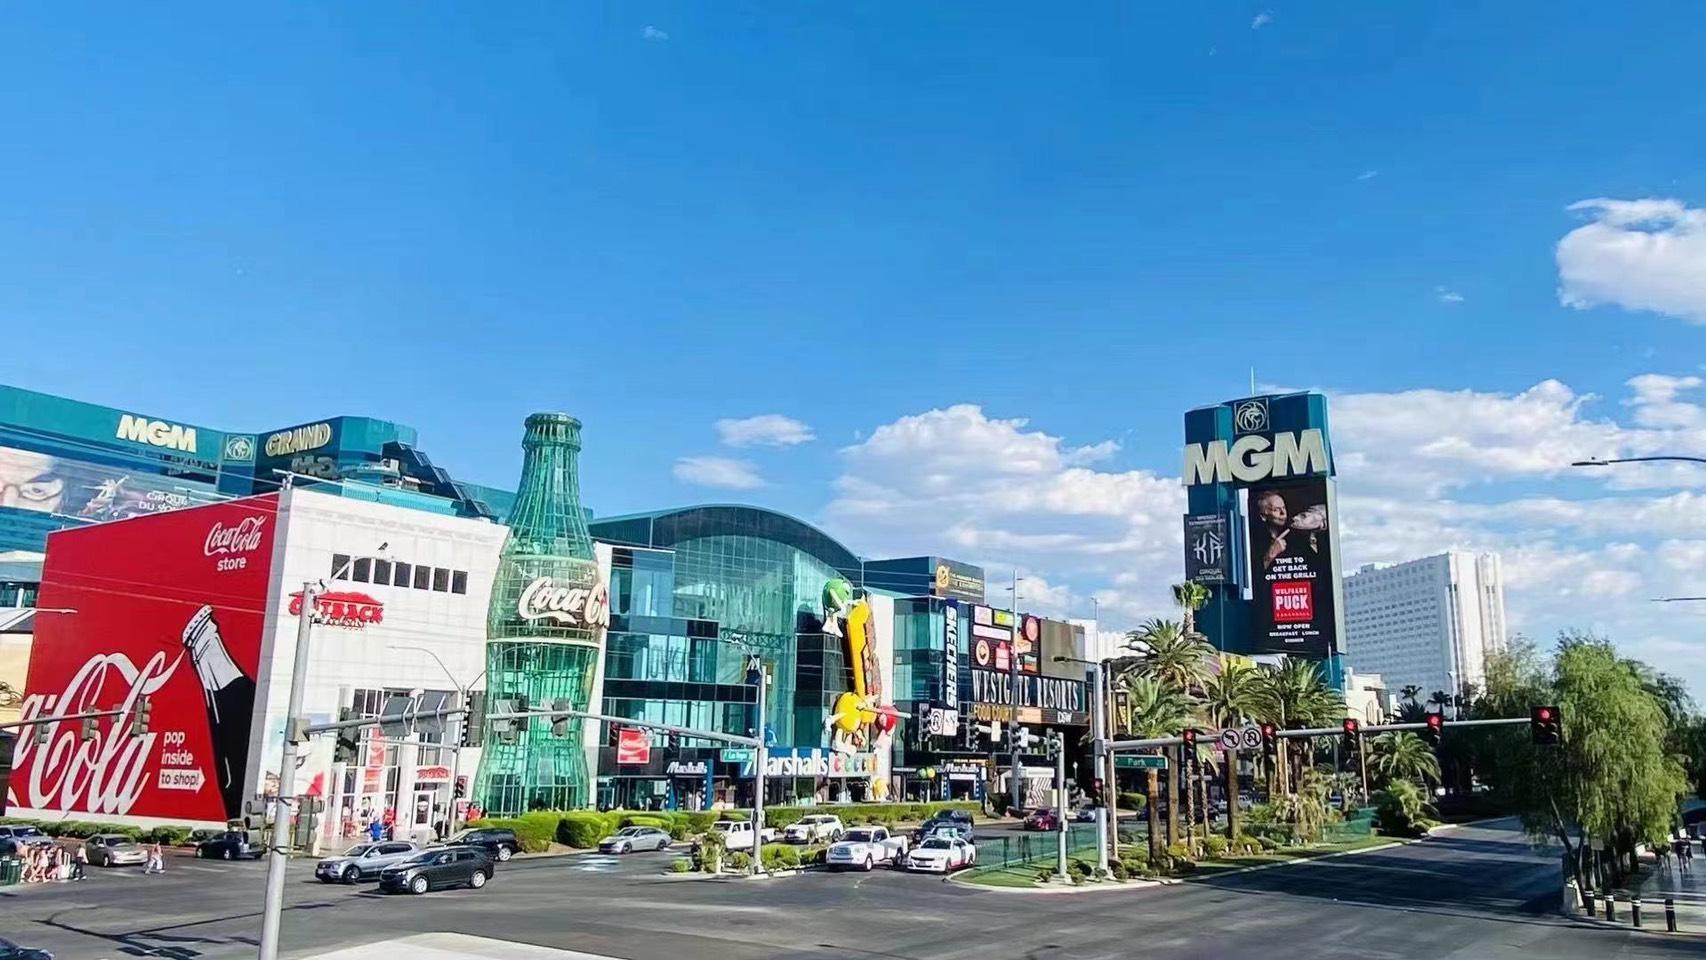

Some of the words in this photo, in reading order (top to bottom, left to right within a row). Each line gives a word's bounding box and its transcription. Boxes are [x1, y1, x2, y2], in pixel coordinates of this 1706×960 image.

[116, 414, 197, 453] MGM
[265, 423, 331, 457] GRAND
[1182, 428, 1328, 486] MGM
[204, 515, 267, 556] Coca-Cola
[217, 557, 247, 571] store
[1275, 595, 1309, 610] PUCK
[946, 605, 957, 709] SKECHERS
[1037, 677, 1079, 710] RESORTS
[163, 731, 186, 748] pop
[161, 749, 194, 766] inside
[1127, 758, 1147, 767] Park
[161, 772, 171, 785] to
[173, 770, 199, 788] shop!
